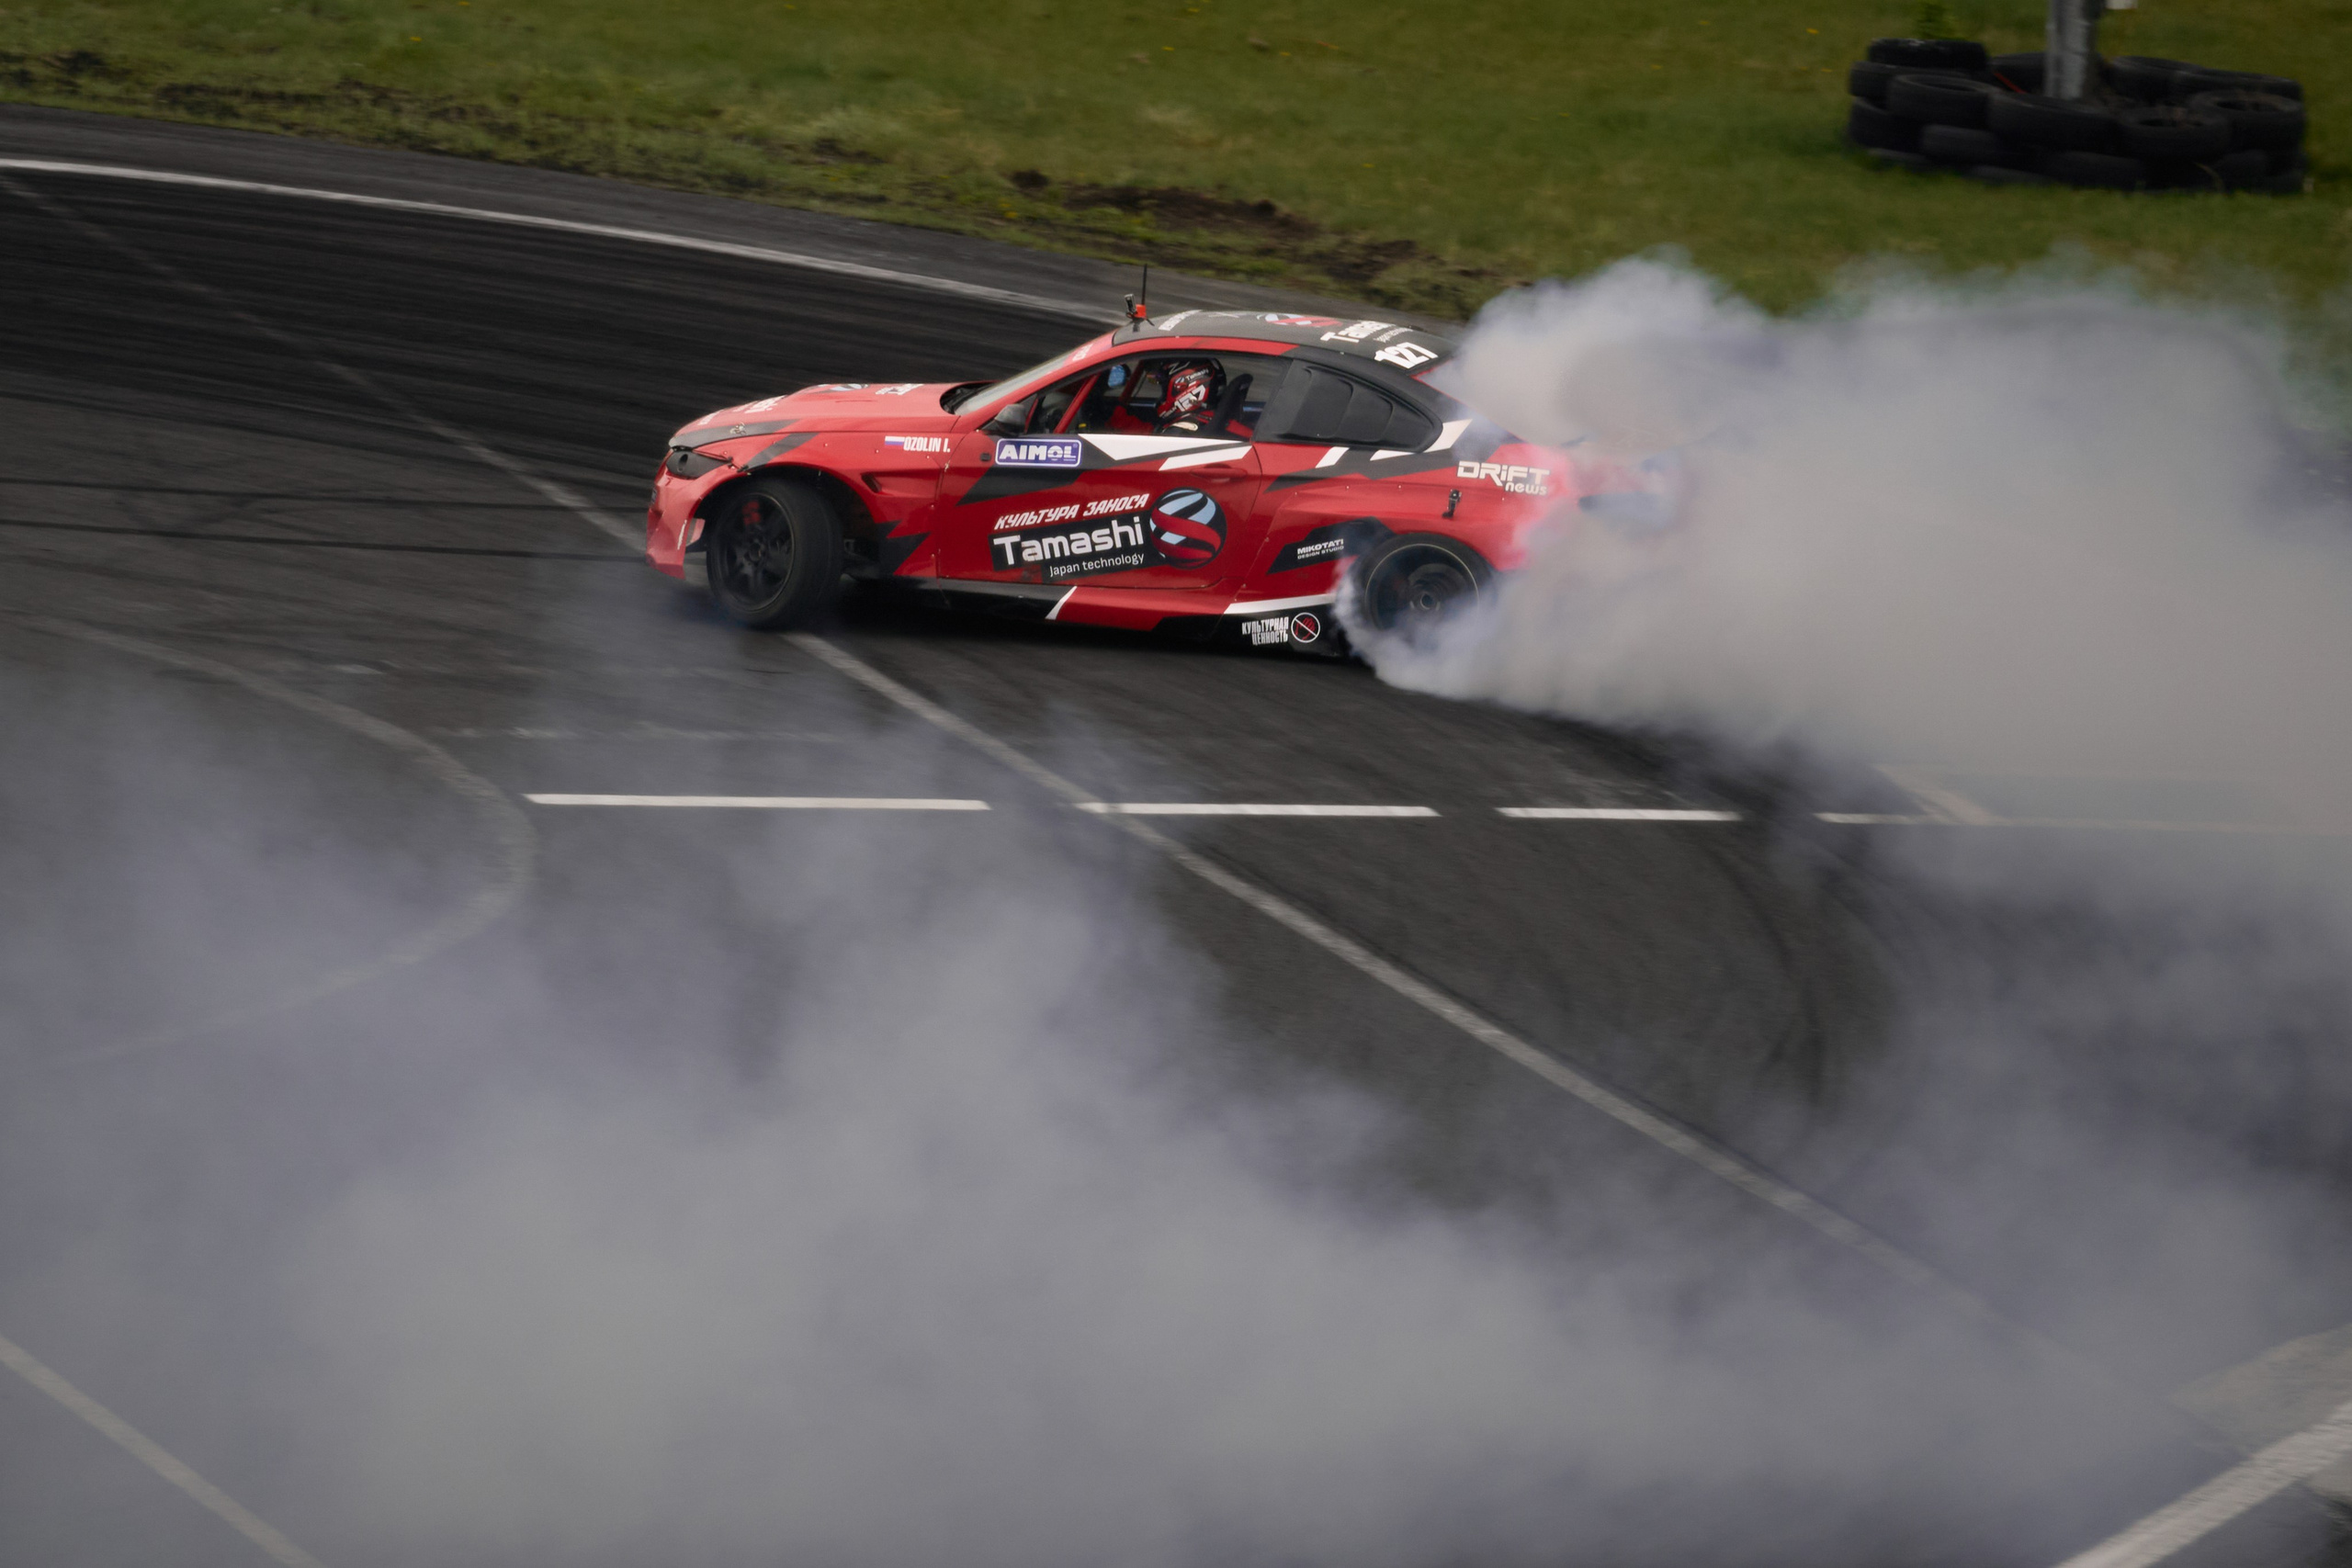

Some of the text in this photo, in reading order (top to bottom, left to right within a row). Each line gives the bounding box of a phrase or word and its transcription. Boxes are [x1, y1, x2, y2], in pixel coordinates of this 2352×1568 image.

[1374, 342, 1438, 369] 127
[904, 436, 951, 453] OZOLIN I.
[999, 445, 1077, 461] AIMOL
[1505, 482, 1548, 496] news
[993, 493, 1150, 530] КУЛЬТУРА ЗАНОСА
[993, 516, 1145, 566] Tamashi
[1296, 538, 1344, 555] MIKOTATI
[1297, 546, 1344, 559] DESIGN STUDIO
[1049, 553, 1145, 577] Japan technology
[1242, 616, 1289, 634] КУЛЬТУРНАЯ
[1252, 630, 1288, 646] ЦЕННОСТЬ
